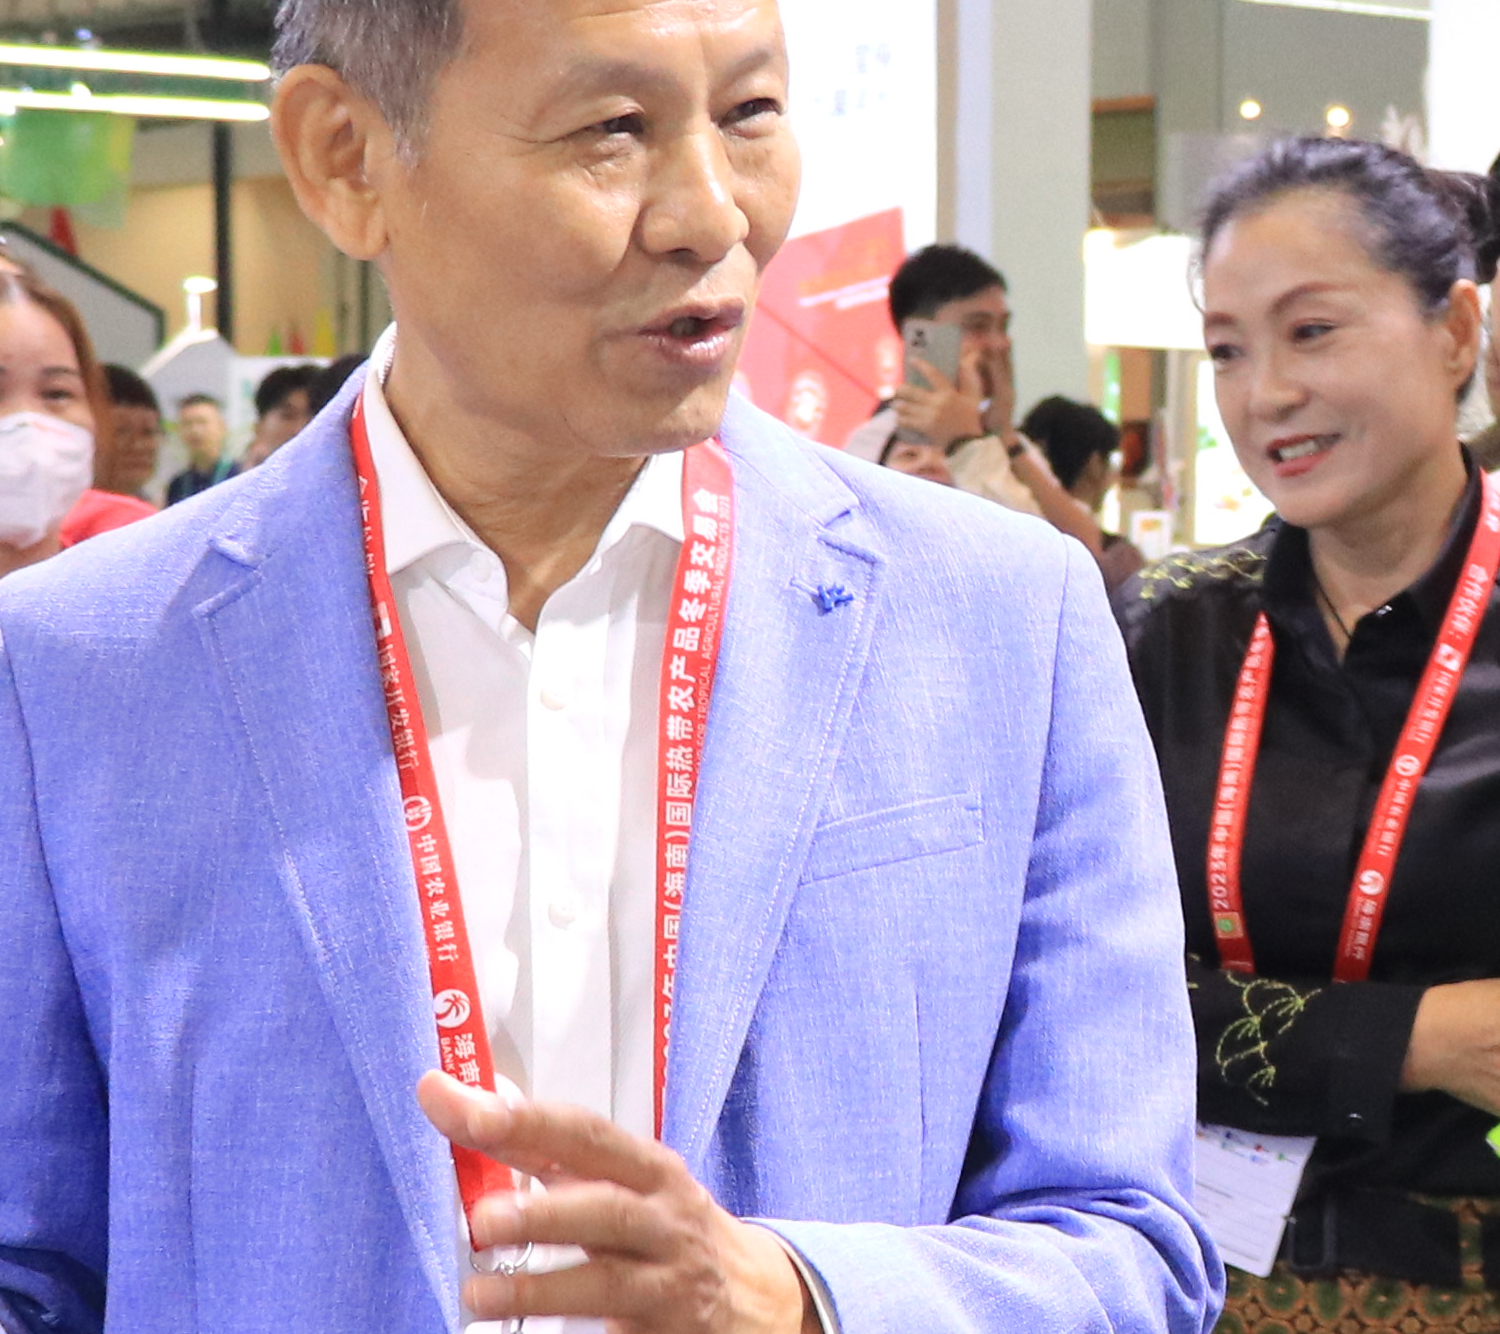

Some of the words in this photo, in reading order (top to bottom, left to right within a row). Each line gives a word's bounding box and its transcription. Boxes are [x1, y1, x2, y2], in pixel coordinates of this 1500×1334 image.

[416, 832, 460, 964] 中国农业银行
